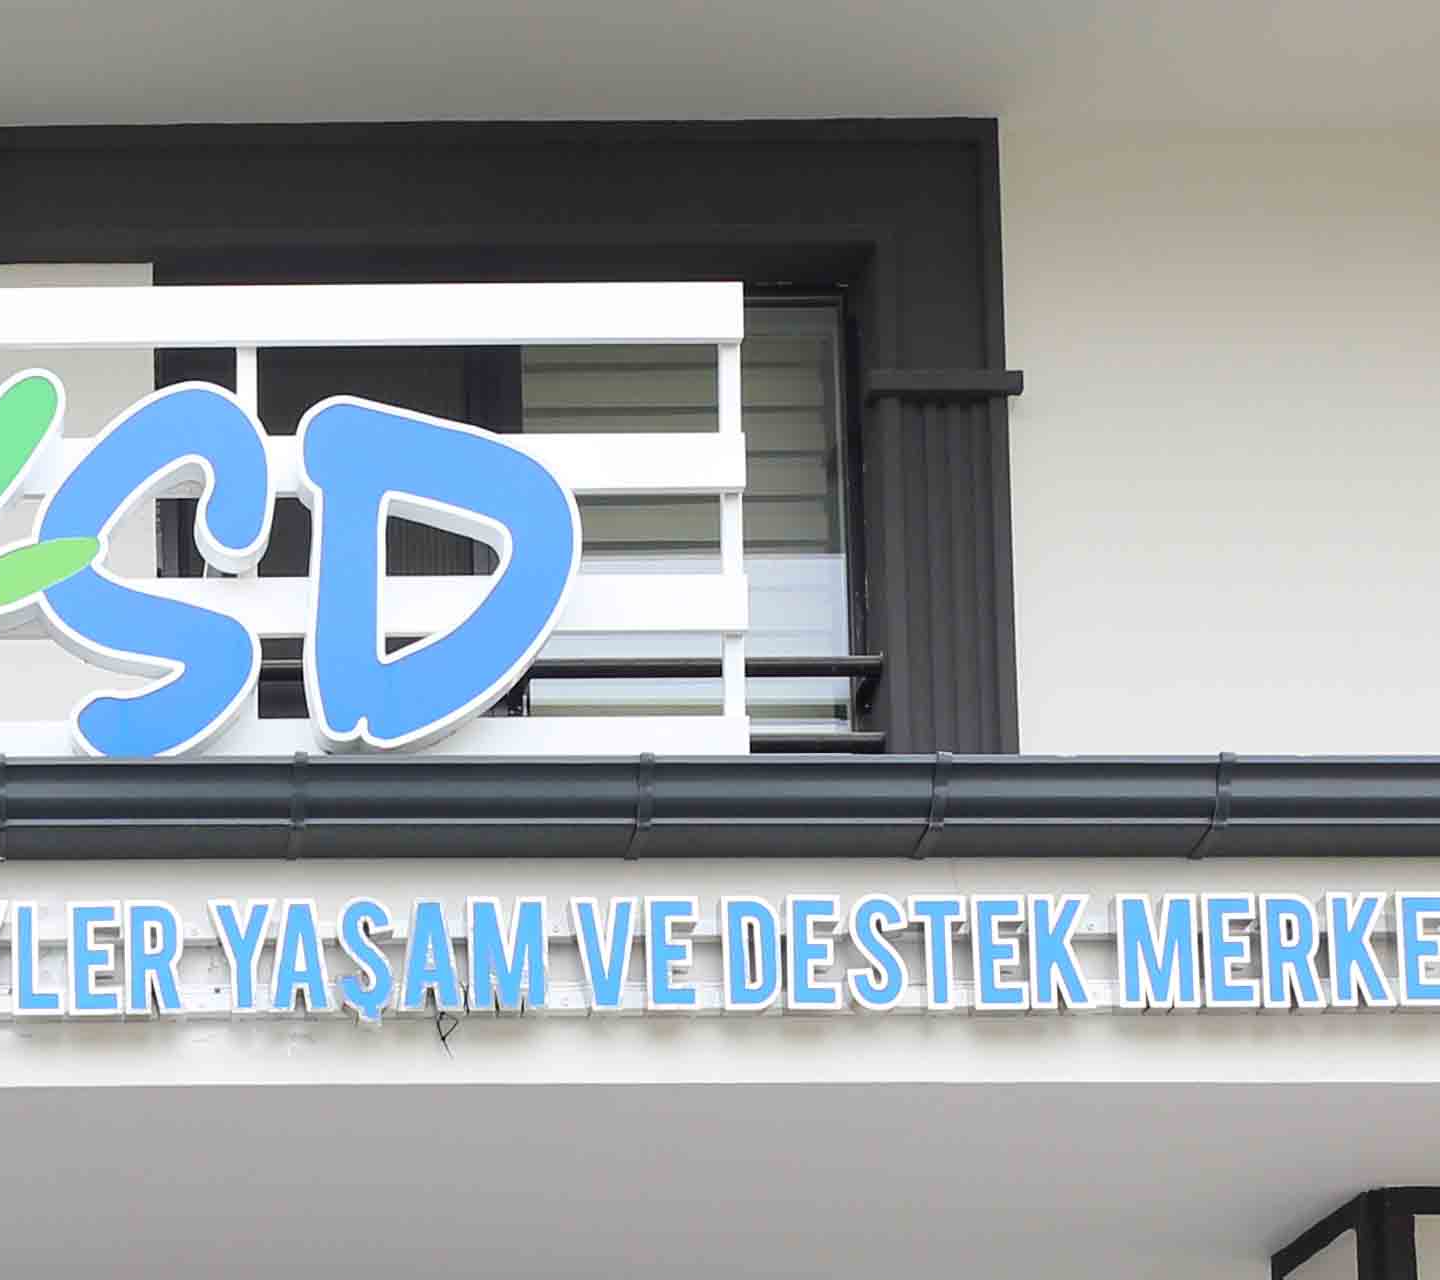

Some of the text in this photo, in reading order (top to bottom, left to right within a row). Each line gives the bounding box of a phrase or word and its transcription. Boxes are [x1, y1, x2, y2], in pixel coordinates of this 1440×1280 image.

[211, 897, 550, 1022] YAŞAM
[573, 897, 702, 1010] VE
[722, 895, 1092, 1008] DESTEK
